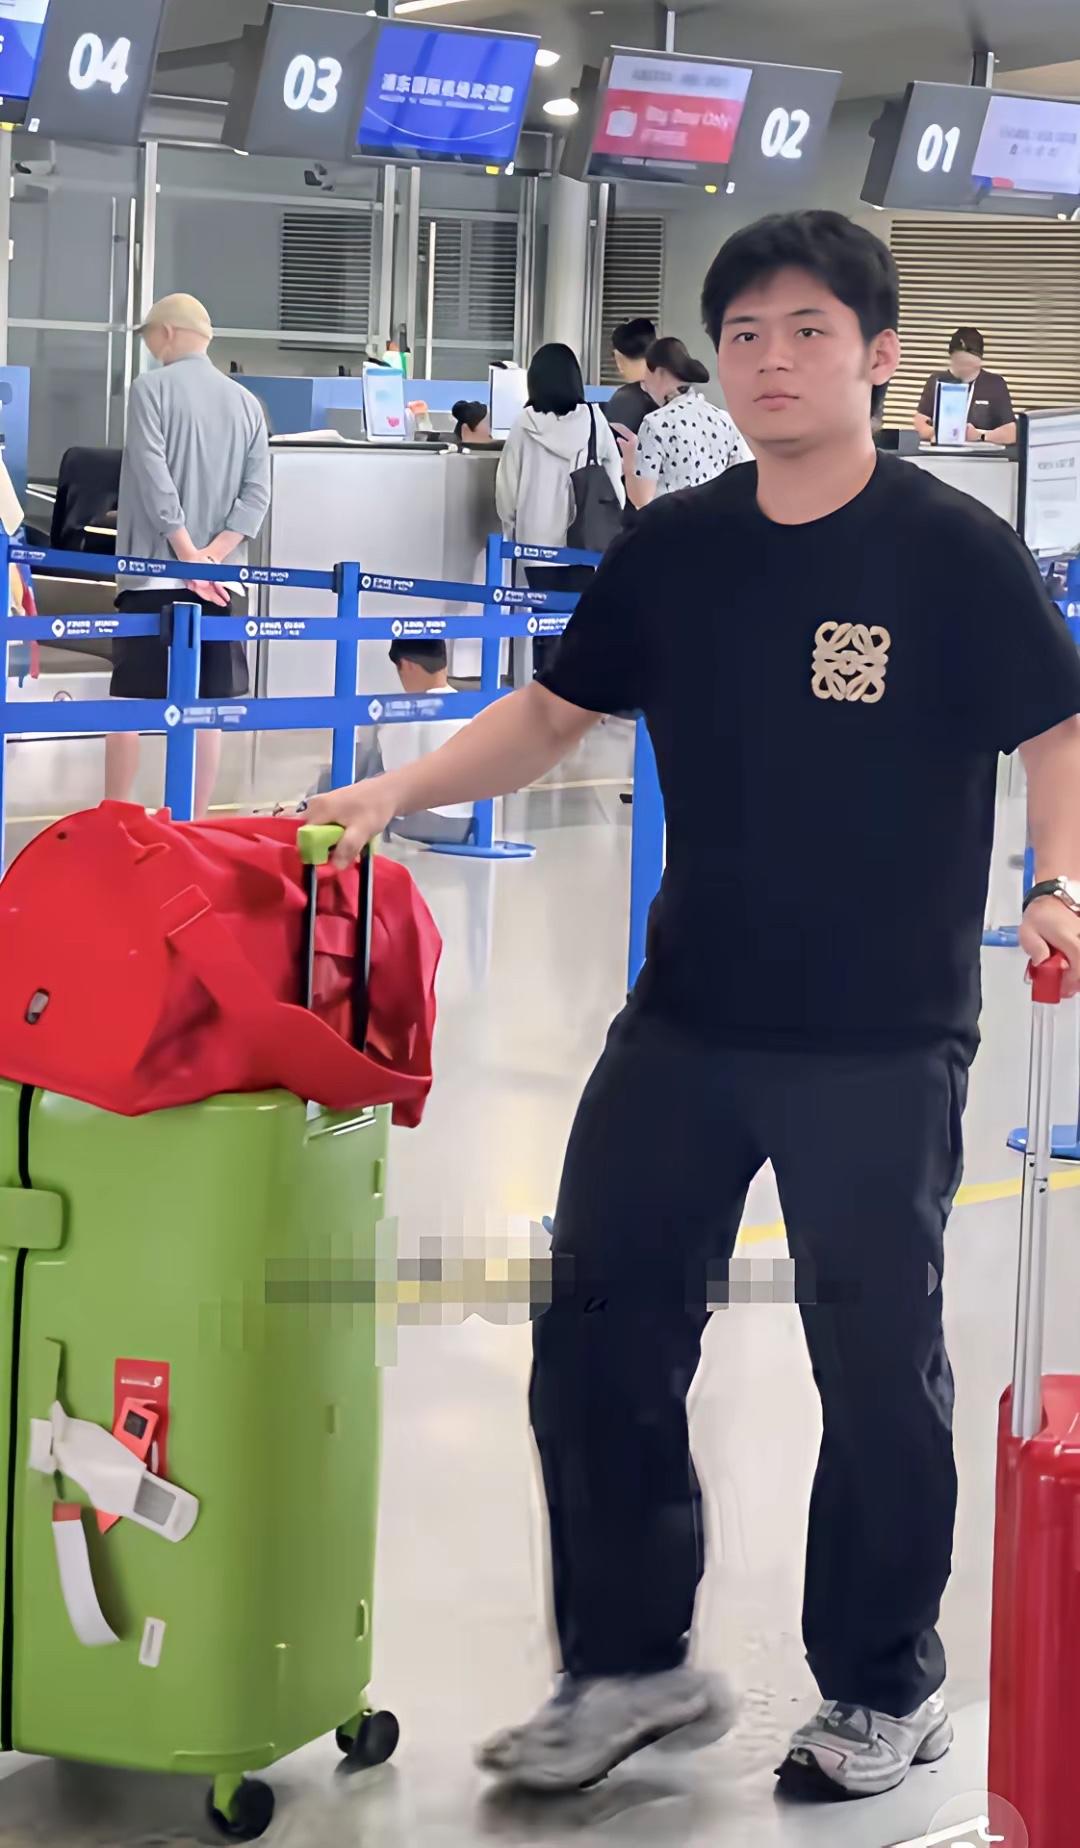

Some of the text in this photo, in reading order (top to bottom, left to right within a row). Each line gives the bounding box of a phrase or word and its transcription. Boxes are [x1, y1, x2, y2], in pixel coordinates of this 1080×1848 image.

[68, 32, 131, 94] 04
[283, 54, 342, 112] 03
[760, 107, 810, 159] 02
[916, 123, 961, 173] 01
